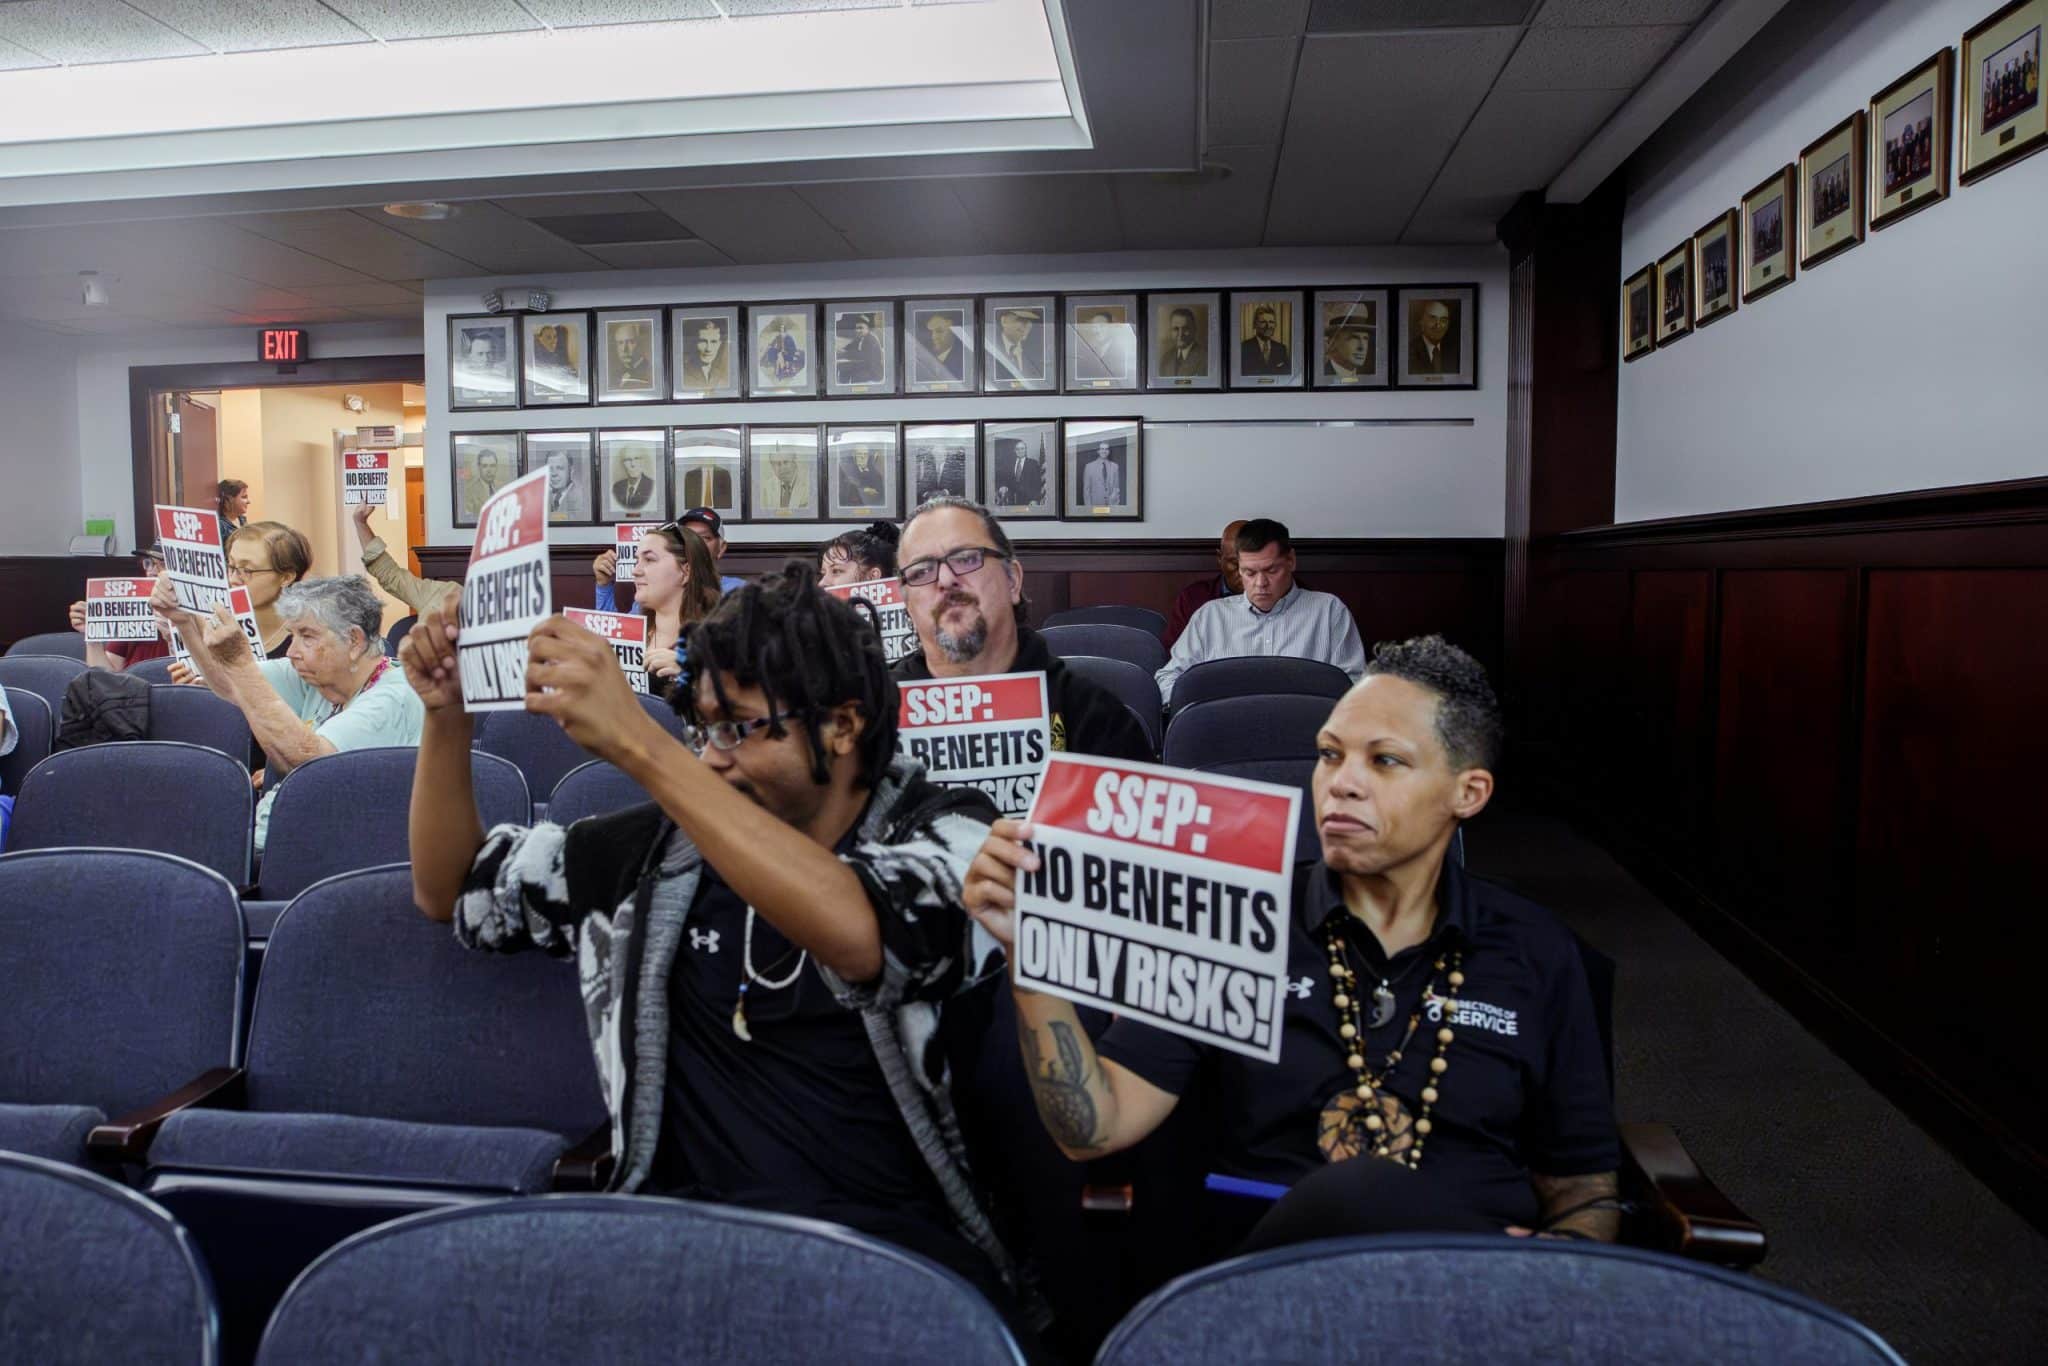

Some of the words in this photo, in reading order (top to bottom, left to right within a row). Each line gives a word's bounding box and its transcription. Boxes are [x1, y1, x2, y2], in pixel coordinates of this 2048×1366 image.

[265, 331, 299, 359] EXIT
[357, 454, 378, 468] SSEP:
[346, 472, 357, 486] NO
[358, 472, 388, 486] BENEFITS
[173, 511, 204, 542] SSEP:
[480, 492, 522, 556] SSEP:
[163, 545, 177, 572] NO
[177, 549, 224, 580] BENEFITS
[617, 545, 631, 560] NO
[104, 580, 137, 597] SSEP:
[477, 559, 545, 627] BENEFITS
[87, 601, 102, 617] NO
[104, 601, 154, 617] BENEFITS
[87, 621, 118, 638] ONLY
[118, 620, 156, 638] RISKS!
[584, 613, 622, 638] SSEP:
[906, 684, 994, 726] SSEP:
[910, 728, 1045, 772] BENEFITS
[1087, 770, 1212, 853] SSEP:
[1022, 839, 1073, 904] NO
[1083, 853, 1278, 954] BENEFITS
[1020, 915, 1124, 999] ONLY
[1124, 941, 1276, 1047] RISKS!
